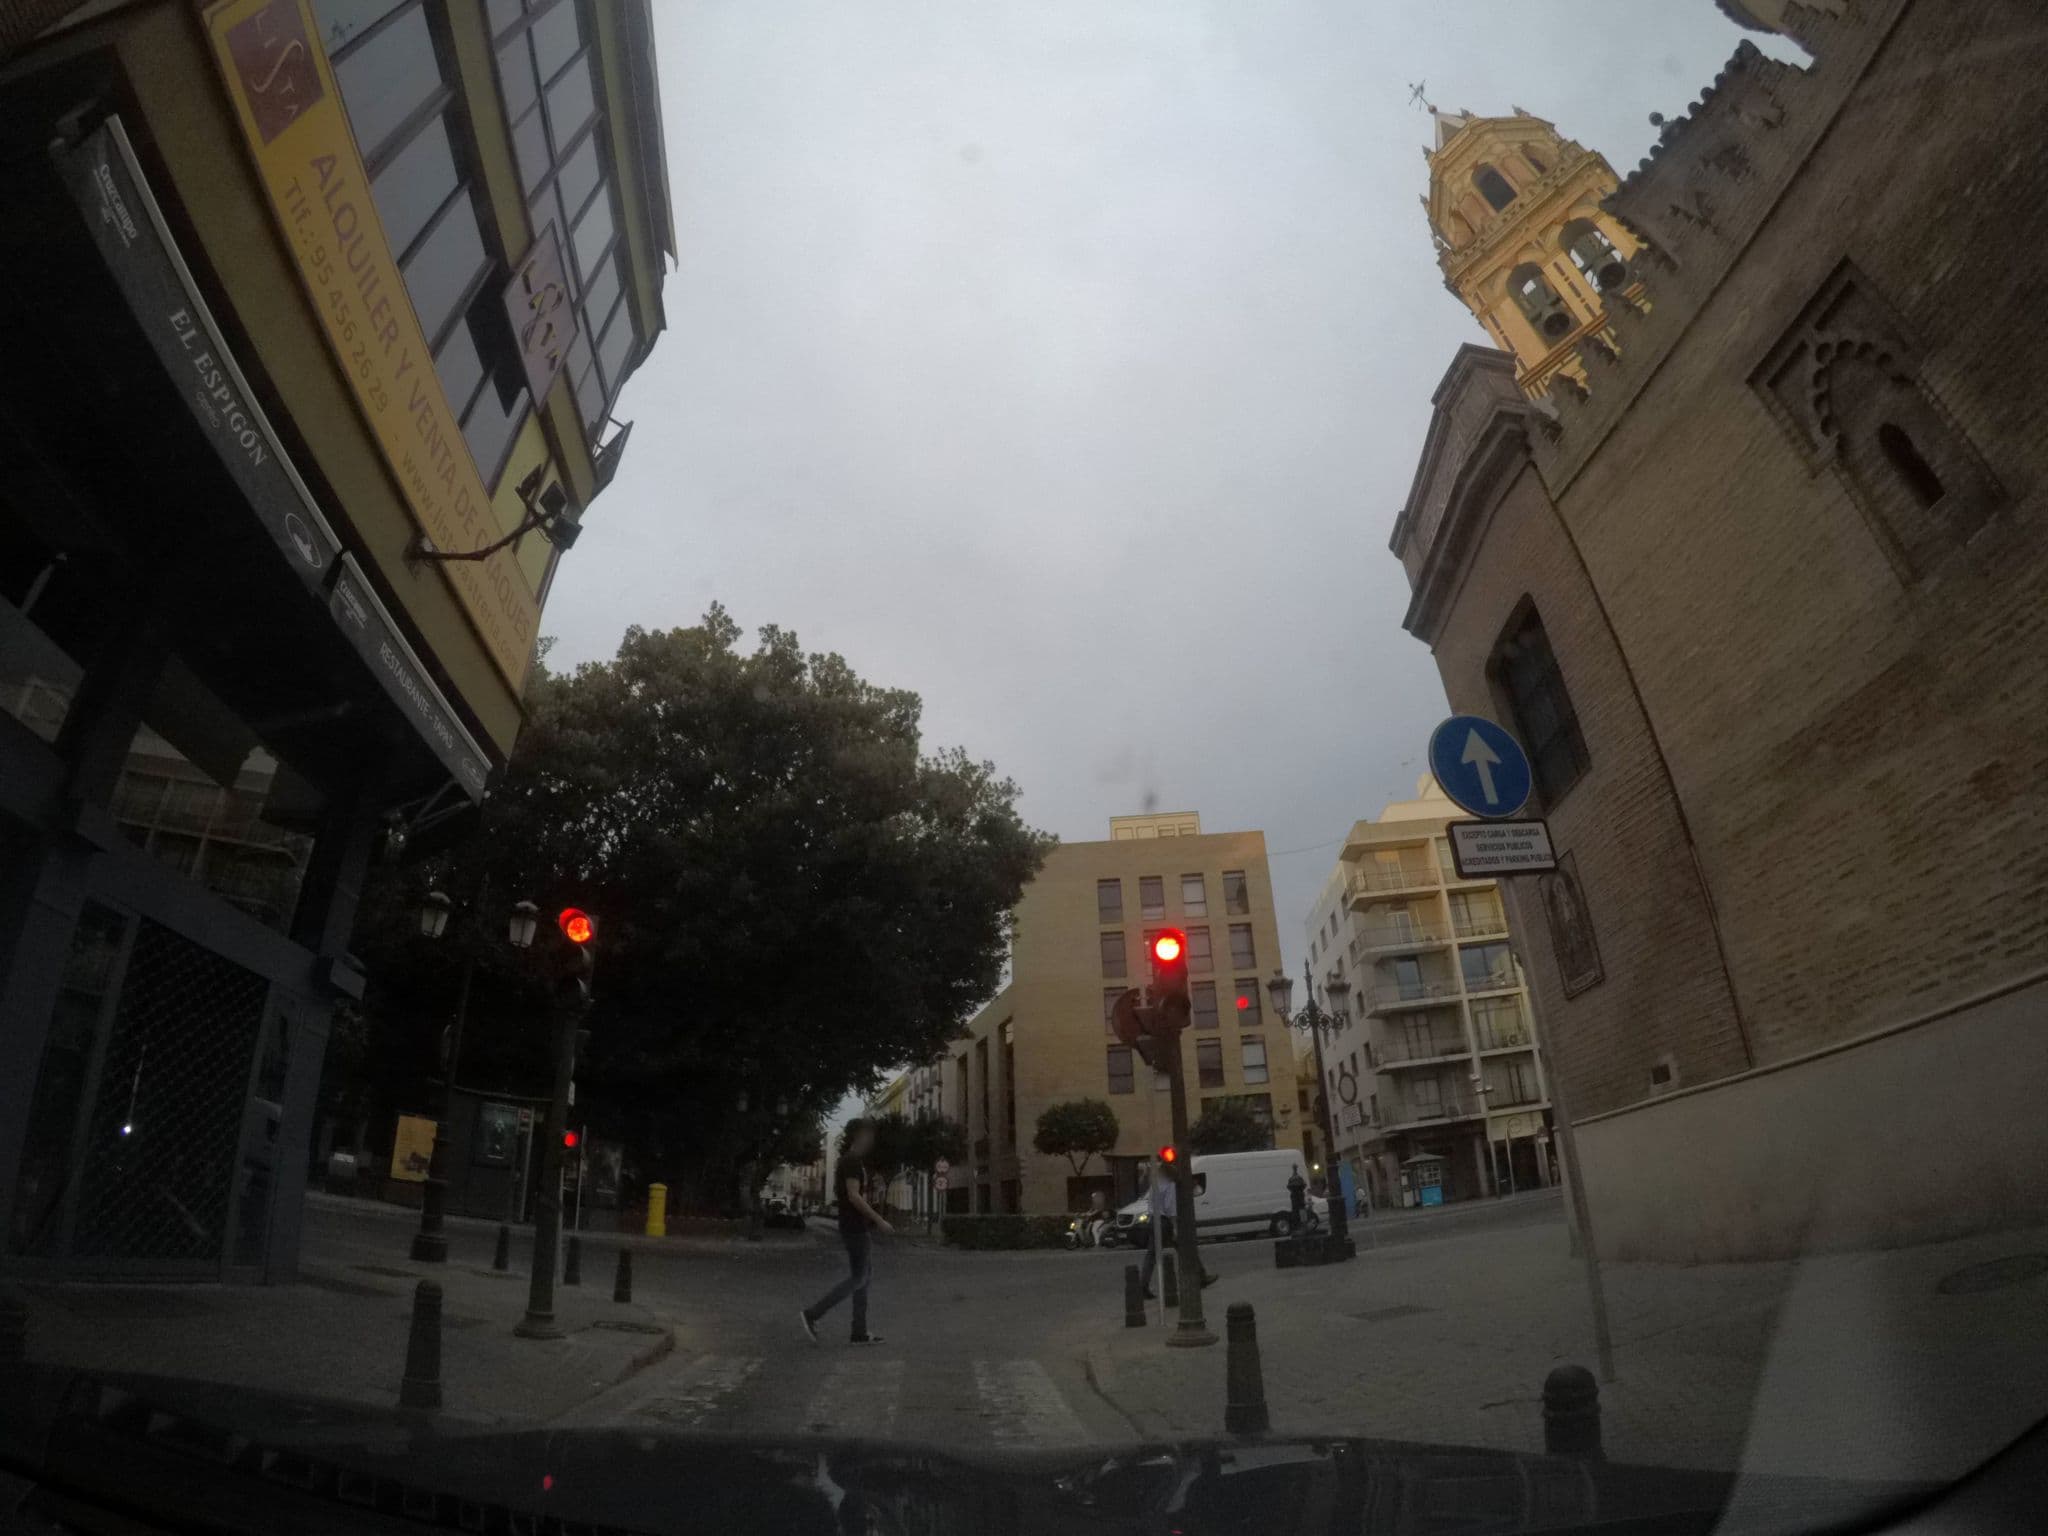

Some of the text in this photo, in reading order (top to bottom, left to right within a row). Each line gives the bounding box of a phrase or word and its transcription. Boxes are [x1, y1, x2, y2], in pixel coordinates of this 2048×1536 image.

[249, 9, 304, 119] LISTA
[169, 307, 268, 467] EL ESPIGÓN
[309, 154, 399, 356] ALQUILER
[394, 346, 414, 379] Y
[408, 377, 457, 496] VENTA
[455, 484, 479, 538] DE
[311, 244, 335, 286] 95
[328, 289, 358, 342] 456
[352, 340, 374, 379] 26
[368, 378, 389, 414] 29
[379, 641, 431, 716] RESTAURANTE
